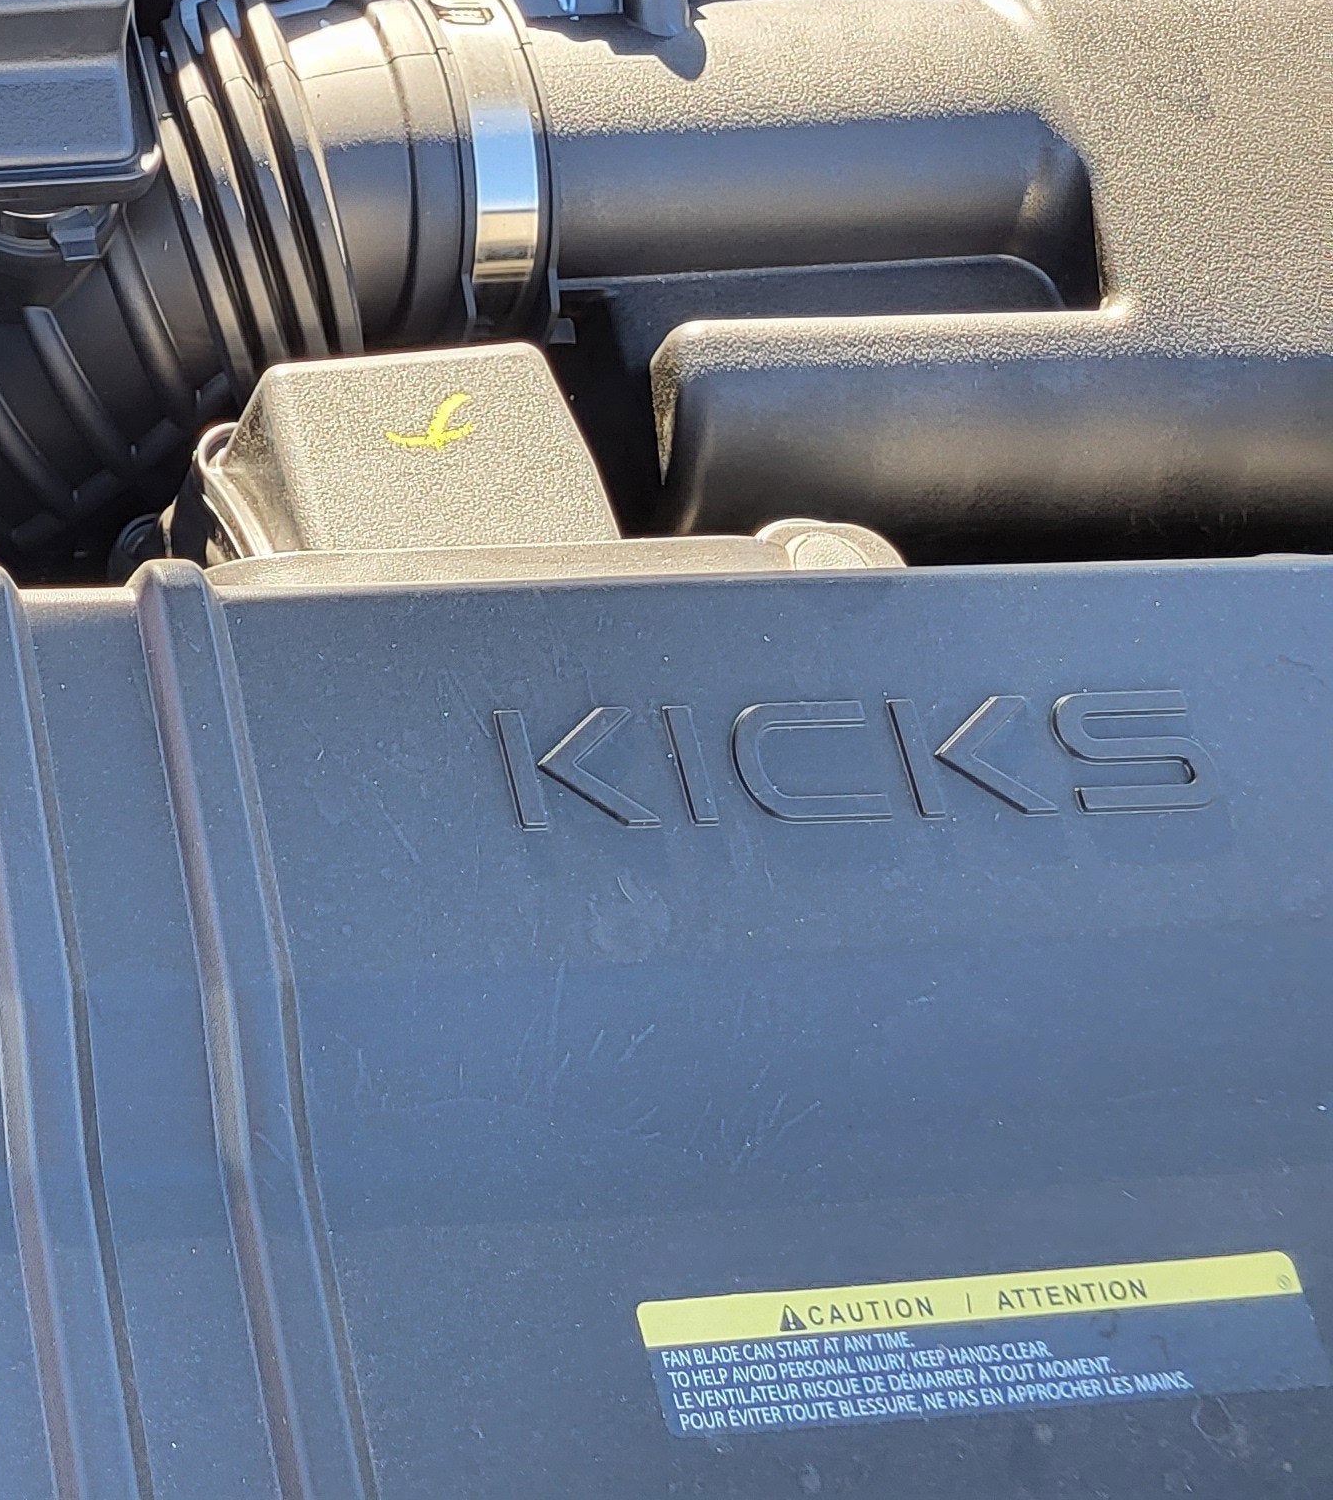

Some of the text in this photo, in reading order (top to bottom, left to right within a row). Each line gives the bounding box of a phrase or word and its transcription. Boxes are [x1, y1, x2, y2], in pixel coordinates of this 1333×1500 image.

[492, 689, 1217, 833] KICKS
[807, 1296, 934, 1327] CAUTION
[997, 1278, 1148, 1311] ATTENTION
[661, 1331, 916, 1370] FAN BLADE CAN START AT ANY TIME.
[667, 1340, 1054, 1389] TO HELP AVOID PERSONAL INJURY, KEEP HANDS CLEAR.
[672, 1356, 1117, 1411] LE VENTILATEUR RISQUE DE DÉMARRER À TOUT MOMENT.
[679, 1409, 729, 1432] POUR
[727, 1402, 784, 1429] ÉVITER
[782, 1402, 841, 1424] TOUTE
[840, 1394, 924, 1420] BLESSURE,
[922, 1391, 951, 1412] NE
[949, 1388, 981, 1409] PAS
[981, 1386, 1006, 1406] EN
[1005, 1376, 1104, 1404] APPROCHER
[1104, 1377, 1134, 1398] LES
